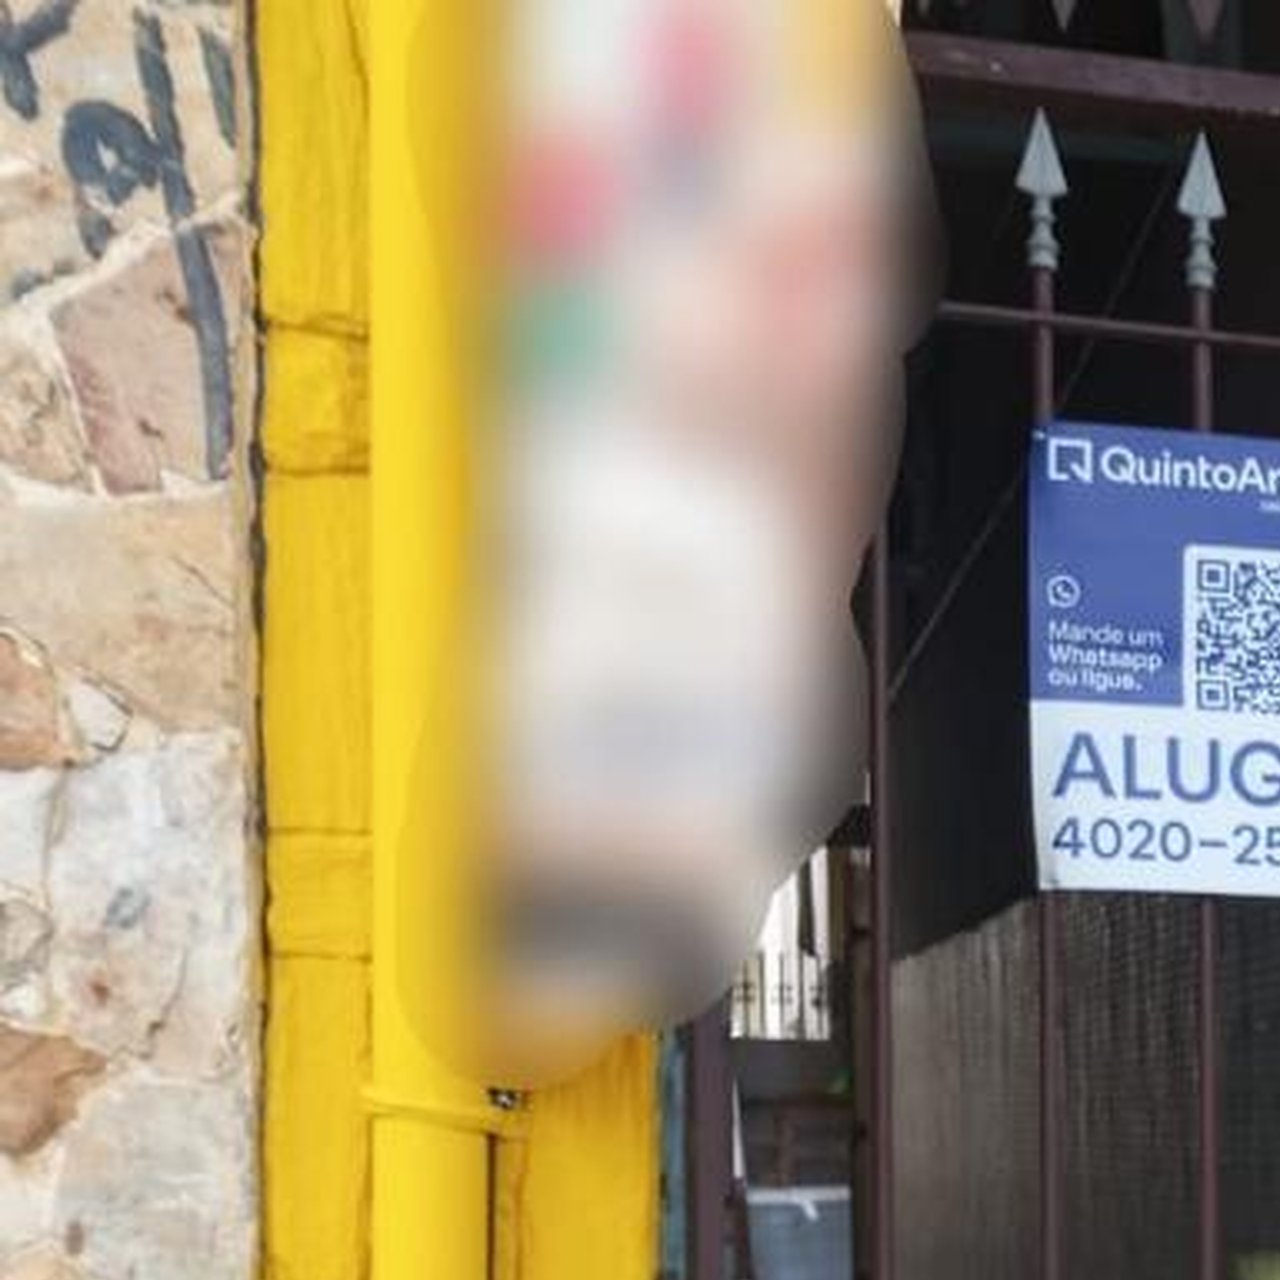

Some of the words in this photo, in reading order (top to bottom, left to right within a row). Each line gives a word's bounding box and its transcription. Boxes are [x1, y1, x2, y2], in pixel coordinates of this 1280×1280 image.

[1048, 620, 1124, 645] Mande
[1128, 629, 1165, 648] um
[1048, 643, 1163, 674] Whatsapp
[1048, 667, 1078, 687] ou
[1081, 668, 1143, 693] ligue.
